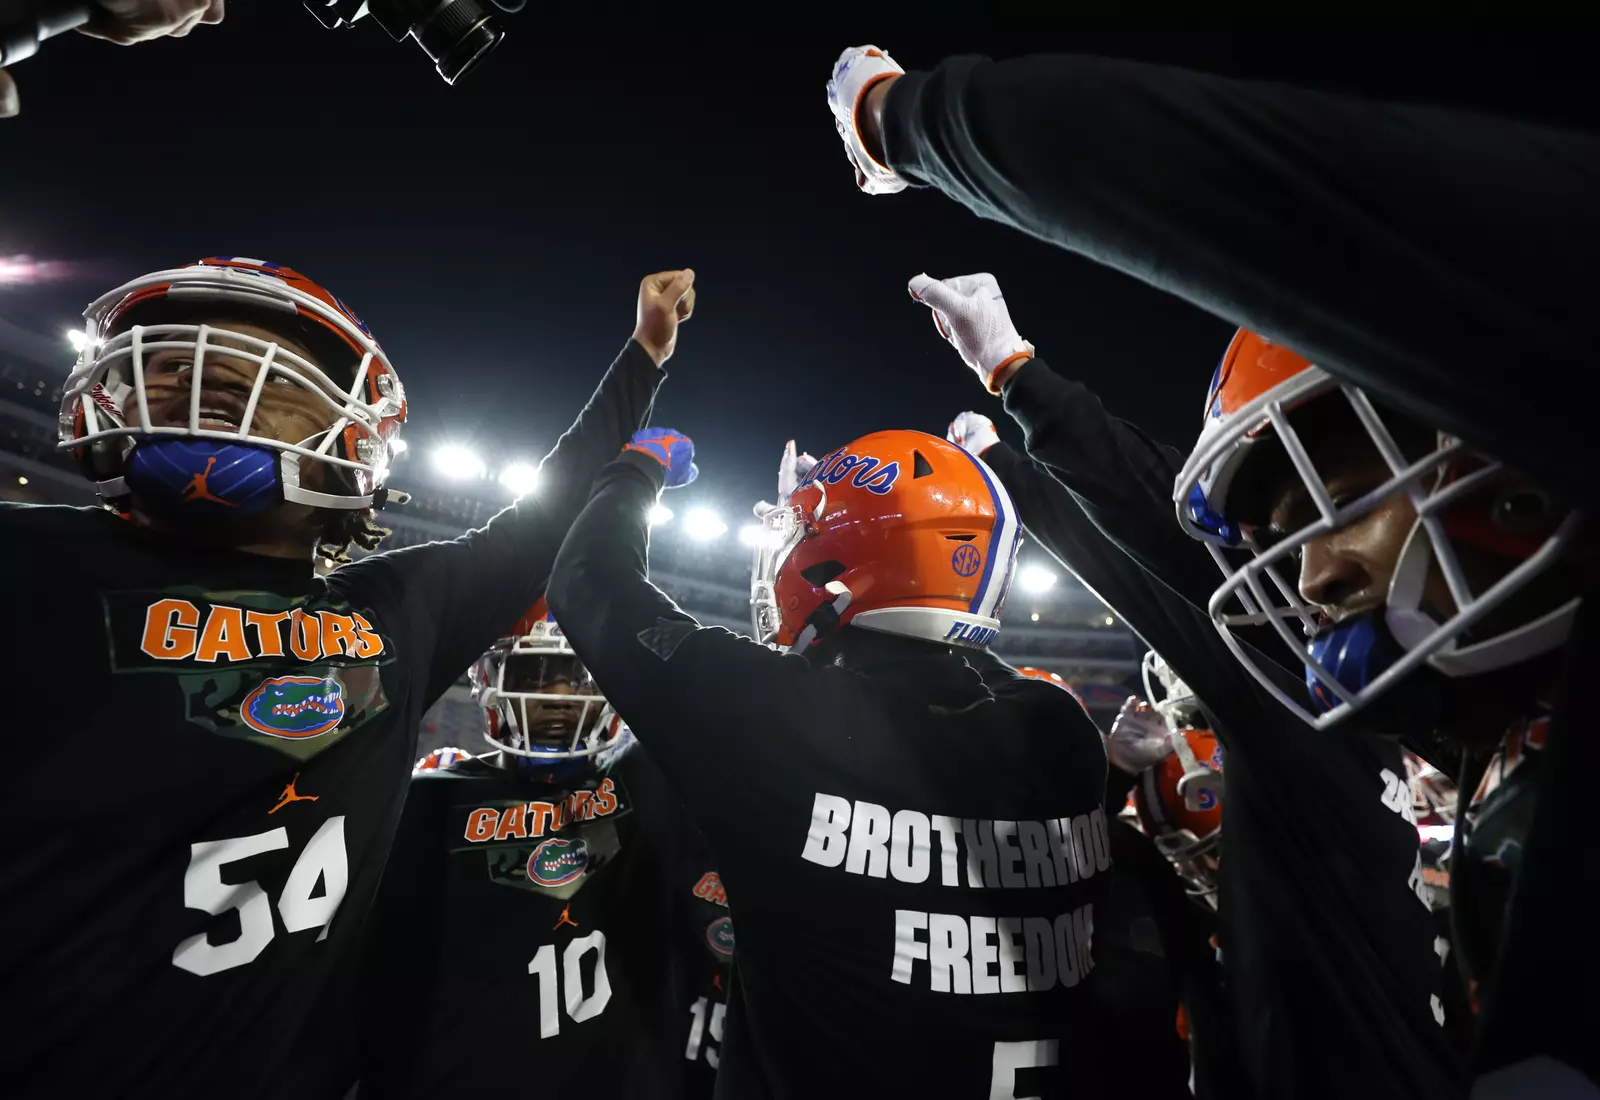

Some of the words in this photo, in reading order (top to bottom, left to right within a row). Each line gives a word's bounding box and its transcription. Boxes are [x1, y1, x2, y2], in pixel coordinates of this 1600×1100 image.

[792, 446, 900, 496] ators
[954, 548, 979, 573] SEC
[140, 598, 384, 662] GATORS
[464, 777, 618, 843] GATORS
[800, 792, 1112, 888] BROTHERHOO
[172, 815, 348, 977] 54
[527, 929, 613, 1040] 10
